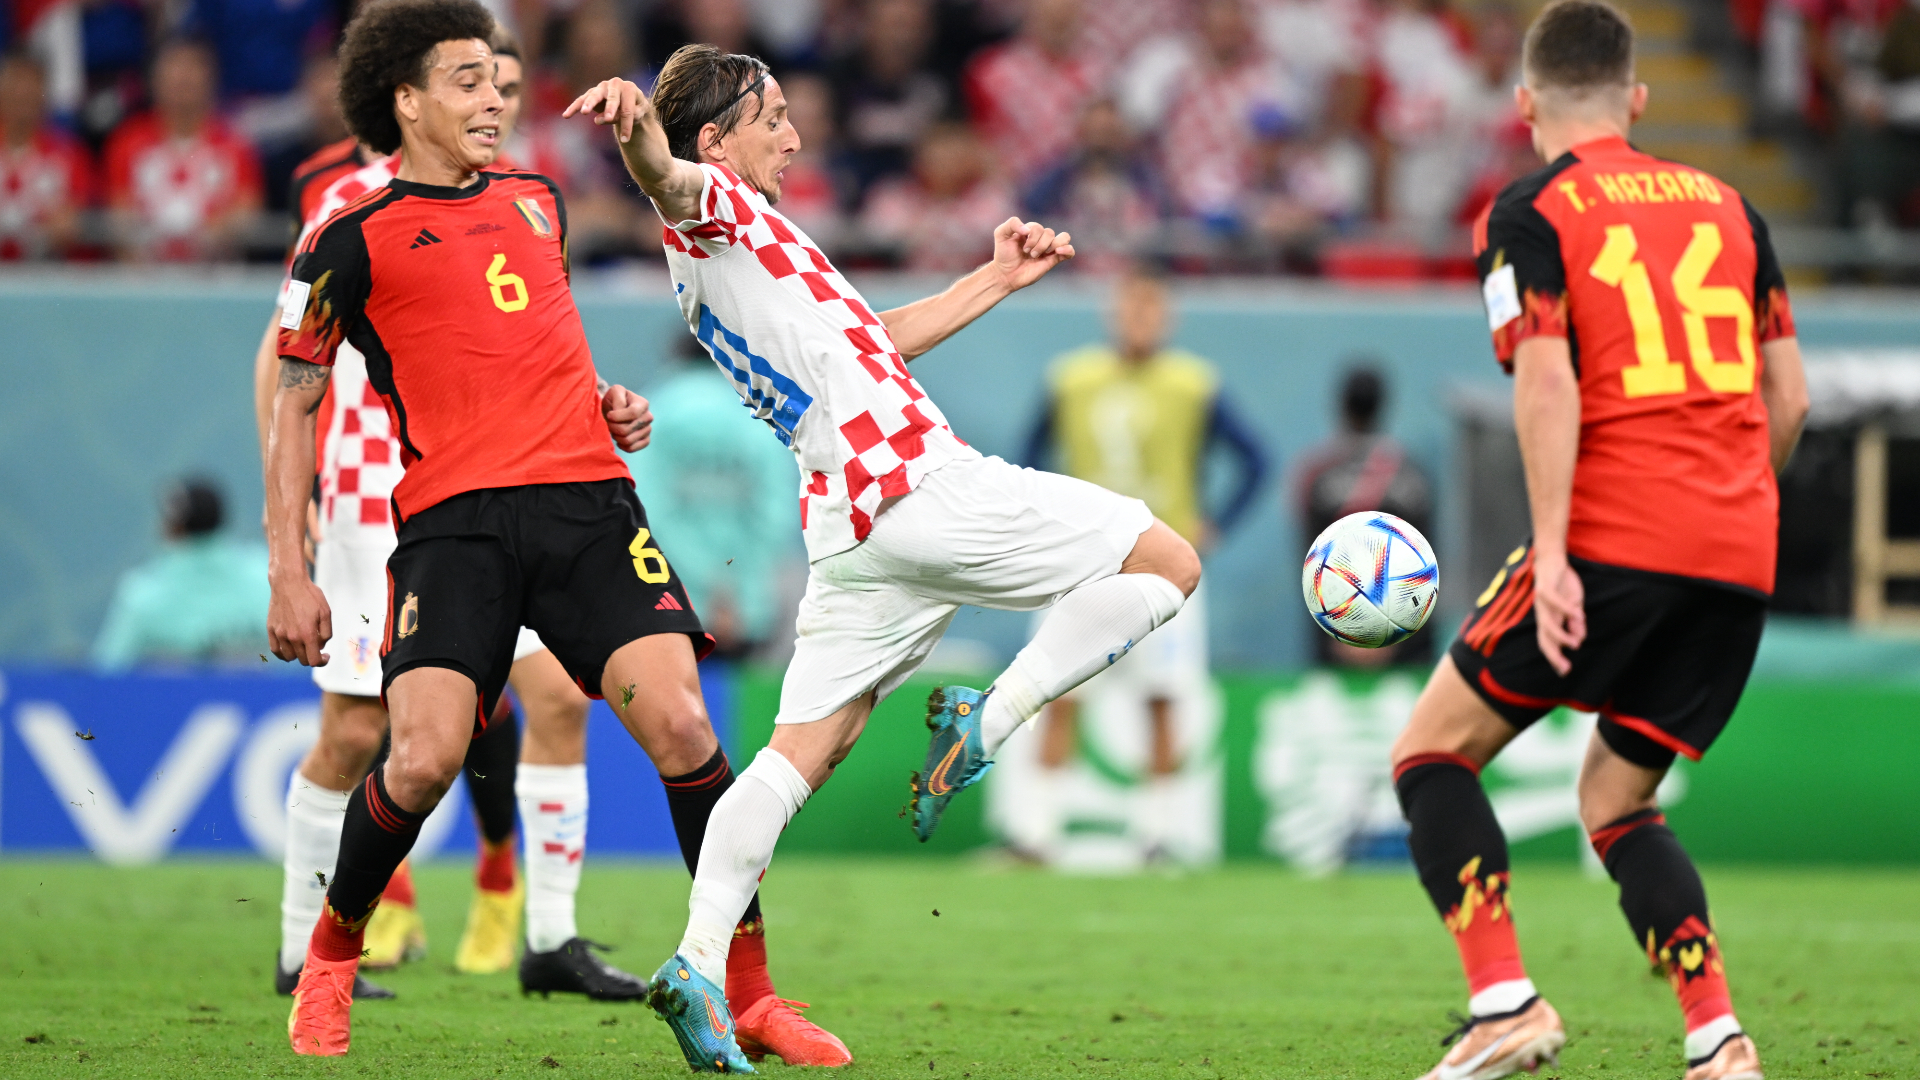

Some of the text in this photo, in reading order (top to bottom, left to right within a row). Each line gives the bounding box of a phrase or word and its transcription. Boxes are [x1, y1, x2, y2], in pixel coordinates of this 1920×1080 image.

[1558, 171, 1723, 214] T. HAZARD
[485, 253, 530, 313] 6
[1589, 222, 1756, 398] 16
[628, 528, 670, 584] 6
